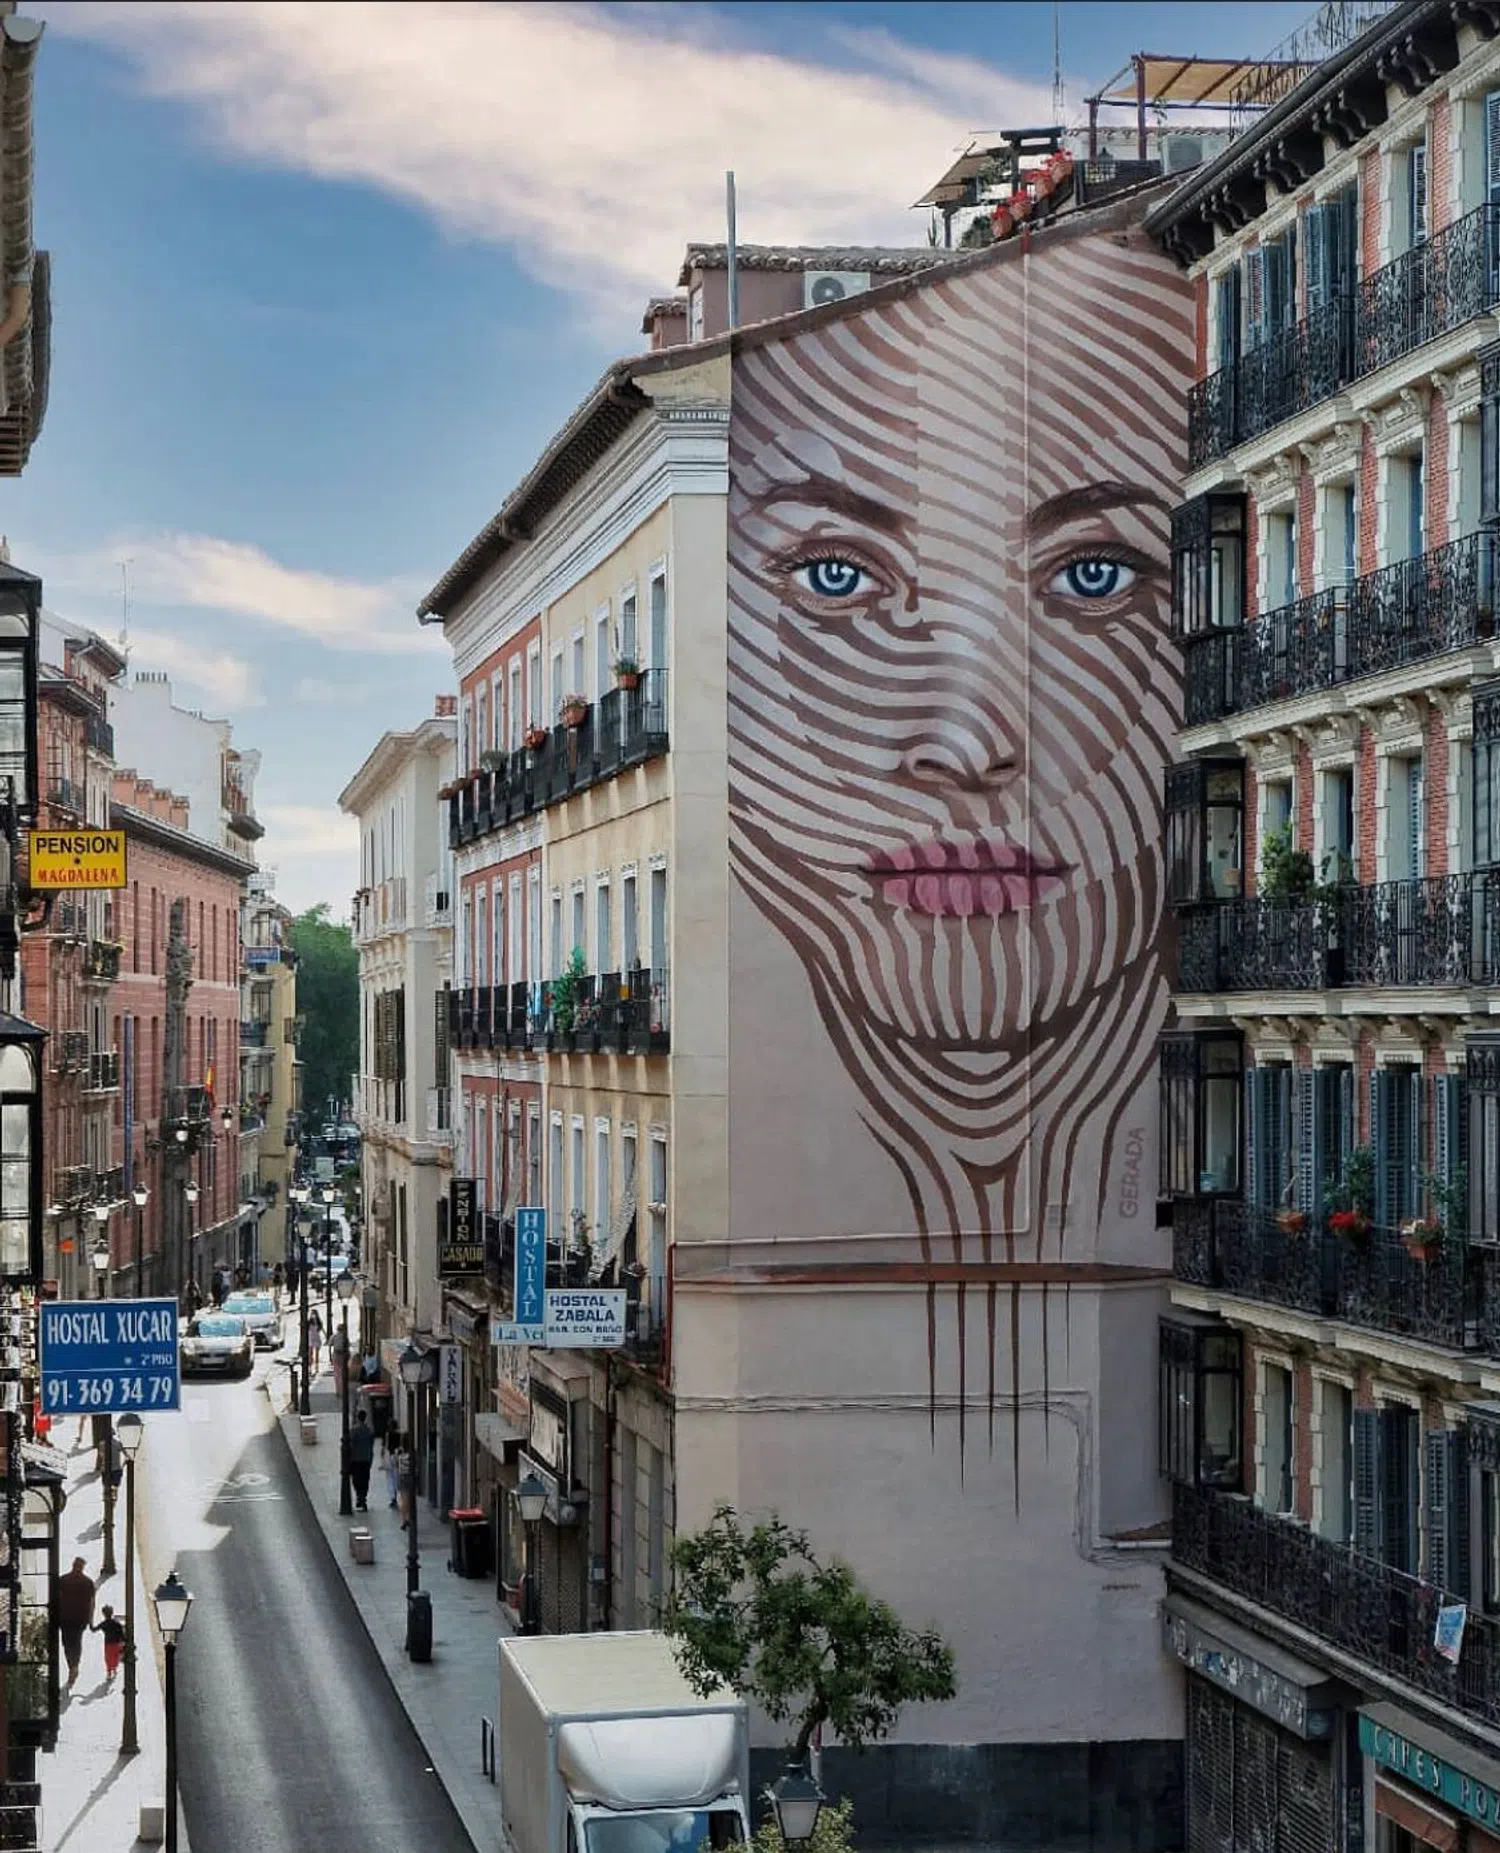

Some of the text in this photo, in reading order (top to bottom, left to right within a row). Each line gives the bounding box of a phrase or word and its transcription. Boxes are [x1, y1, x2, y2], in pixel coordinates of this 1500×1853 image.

[36, 836, 119, 855] PENSION
[38, 868, 119, 882] MAGDALENA
[1119, 1127, 1145, 1218] GERADA
[522, 1212, 540, 1317] HOSTAL
[549, 1296, 607, 1306] HOSTAL
[555, 1309, 615, 1322] ZABALA
[47, 1310, 171, 1344] HOSTAL XUCAR
[151, 1353, 173, 1366] PISO
[78, 1378, 114, 1405] 369
[120, 1377, 143, 1404] 34
[149, 1376, 172, 1403] 79
